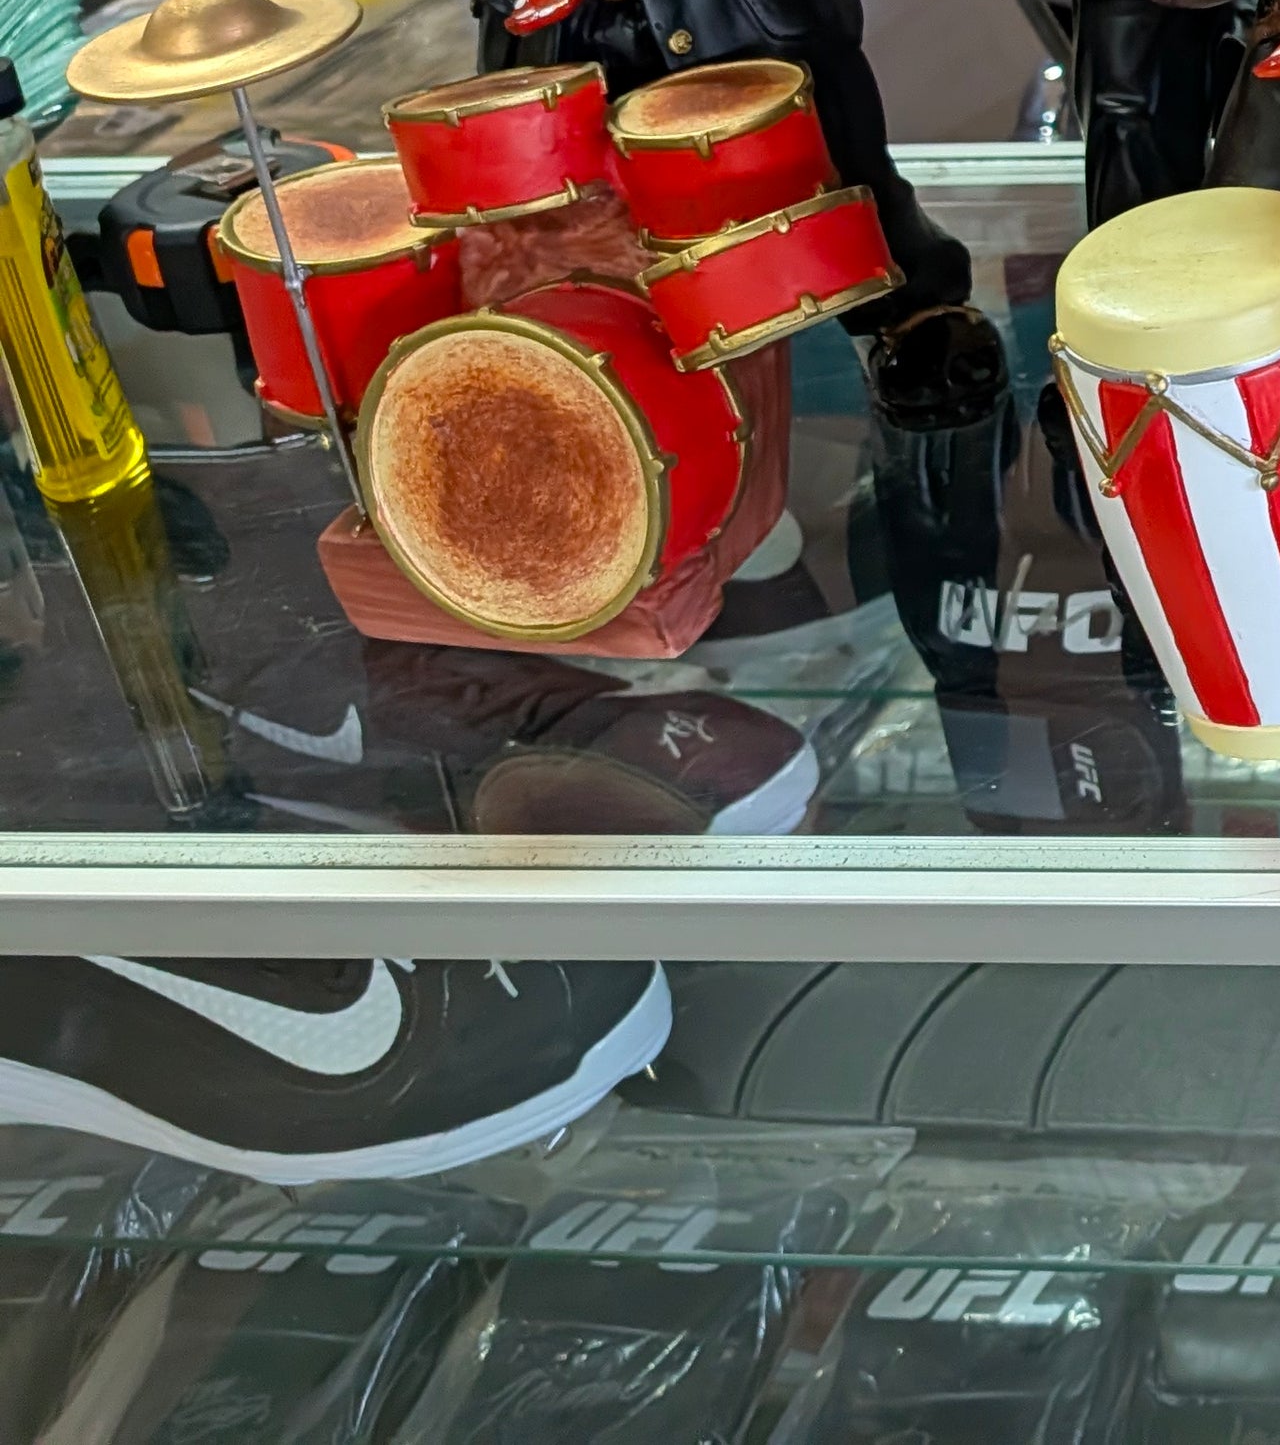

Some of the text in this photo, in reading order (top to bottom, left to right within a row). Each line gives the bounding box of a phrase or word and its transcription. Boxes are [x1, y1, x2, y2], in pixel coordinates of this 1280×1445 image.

[938, 580, 1123, 653] UFC
[1070, 742, 1102, 803] UFC
[198, 1213, 428, 1274] UFC
[528, 1201, 752, 1272] UFC
